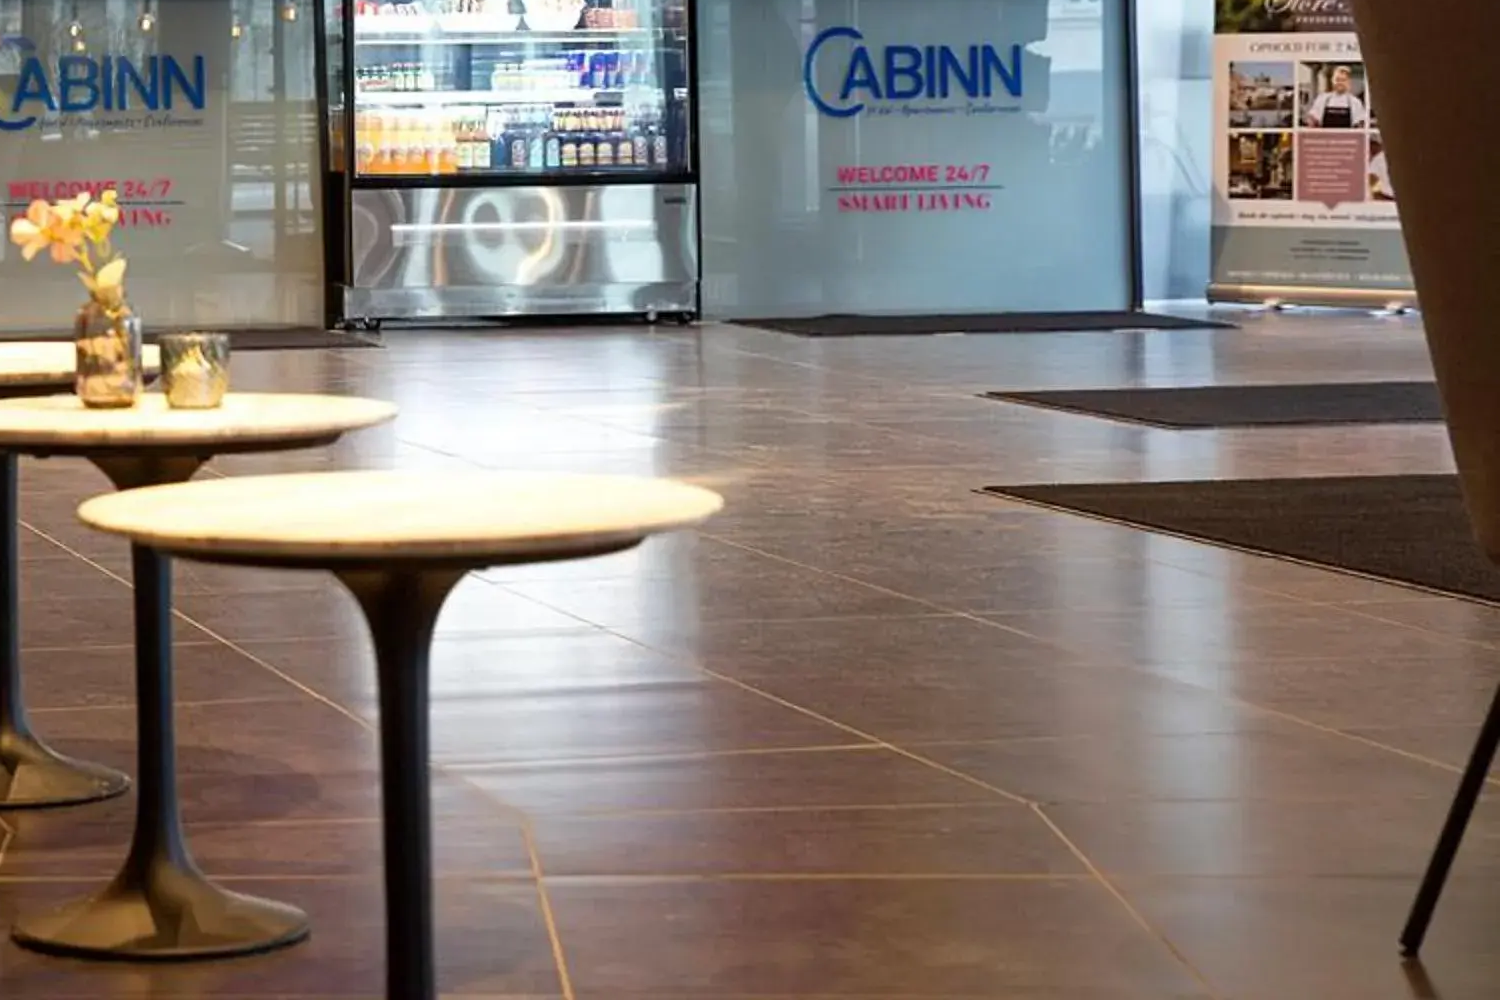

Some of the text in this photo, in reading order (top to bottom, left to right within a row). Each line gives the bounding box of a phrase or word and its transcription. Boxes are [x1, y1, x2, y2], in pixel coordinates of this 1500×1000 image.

[804, 26, 1022, 118] CABINN
[837, 165, 991, 184] WELCOME 24/7
[124, 179, 172, 198] 24/7
[837, 193, 991, 212] SMART LIVING
